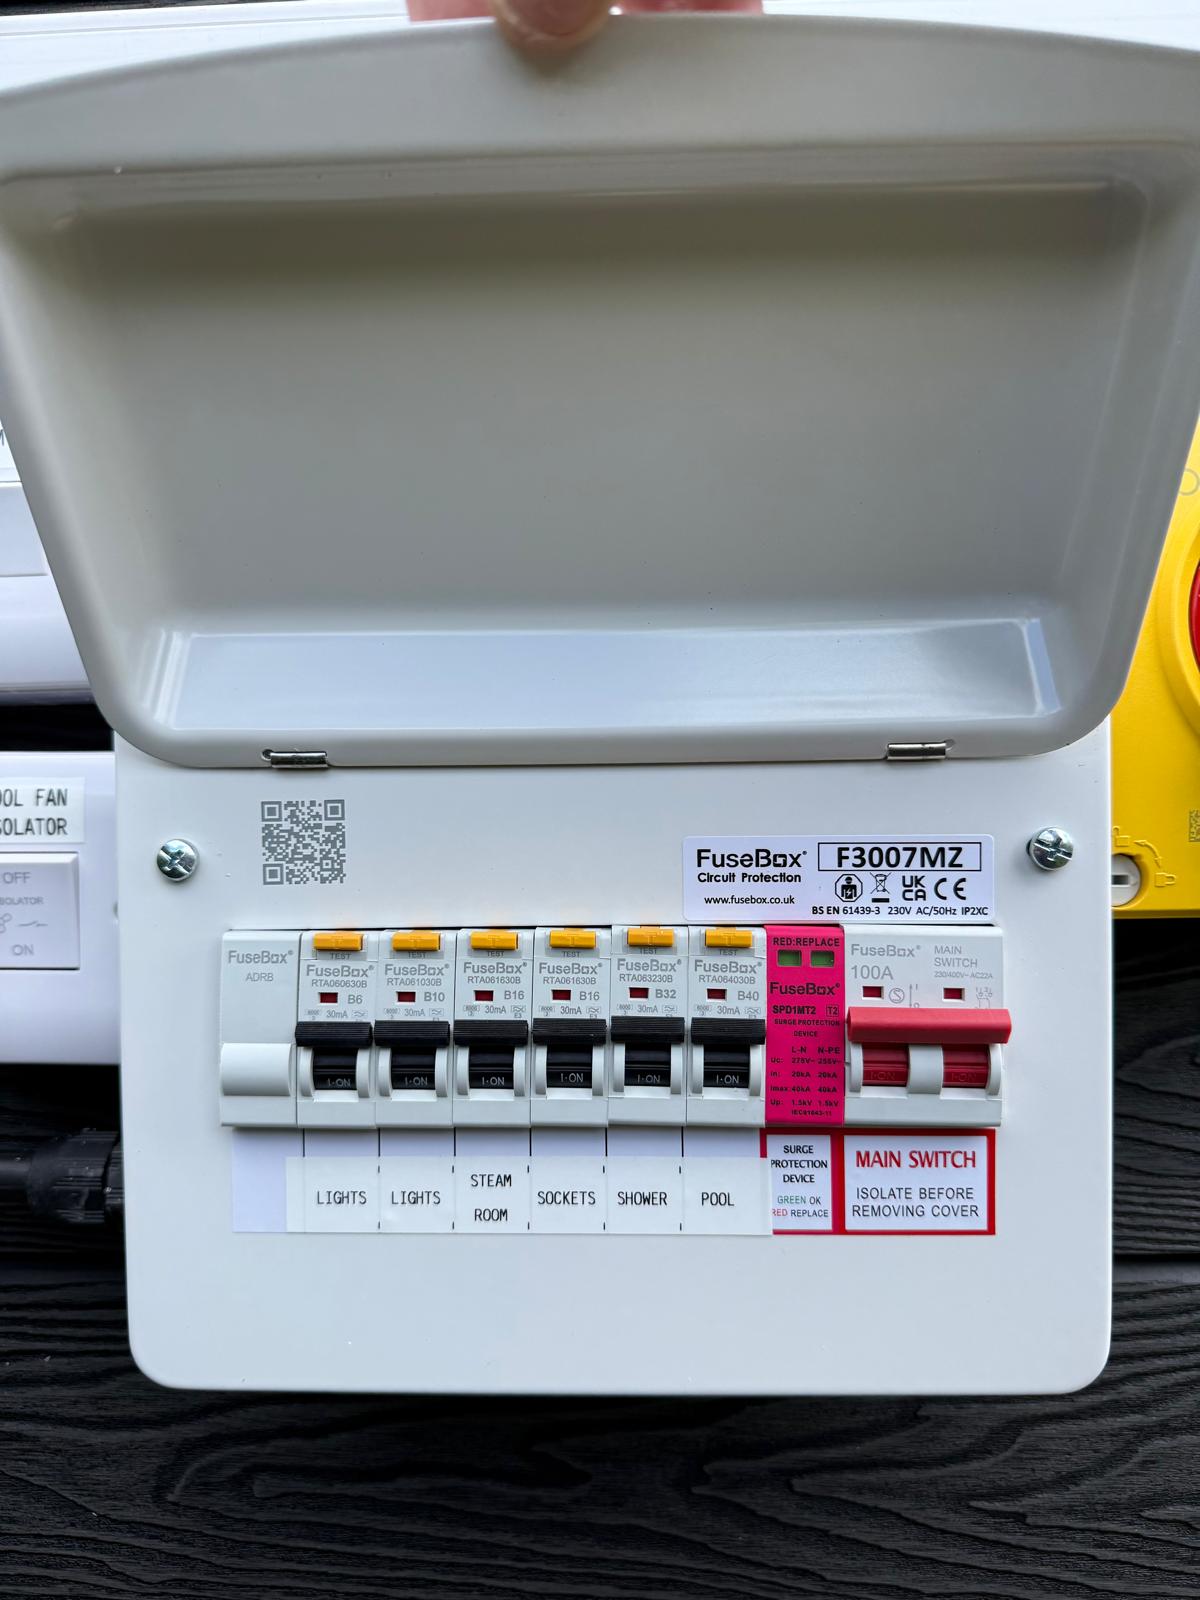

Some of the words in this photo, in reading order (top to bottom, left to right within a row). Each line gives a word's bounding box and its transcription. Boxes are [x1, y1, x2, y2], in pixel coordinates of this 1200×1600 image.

[0, 788, 24, 807] OL
[36, 788, 68, 807] FAN
[0, 817, 68, 836] OLATOR
[837, 847, 963, 869] F3007MZ
[3, 871, 31, 884] OFF
[697, 872, 736, 883] Circuit
[741, 872, 802, 883] Protection
[704, 894, 796, 905] www.fusebox.co.uk
[812, 905, 824, 915] BS
[826, 905, 840, 915] EN
[842, 905, 881, 915] 61439-3
[888, 905, 912, 915] 230V
[916, 905, 957, 917] AC/50Hz
[961, 906, 989, 916] IP2XC
[773, 937, 840, 947] RED:REPLACE
[12, 944, 34, 956] ON
[934, 946, 962, 955] MAIN
[934, 957, 978, 968] SWITCH
[245, 972, 274, 982] ADRB
[850, 965, 894, 981] 100A
[347, 994, 363, 1005] B6
[423, 992, 445, 1002] B10
[504, 990, 525, 1000] B16
[579, 991, 600, 1001] B16
[655, 989, 677, 999] B32
[737, 991, 759, 1001] B40
[326, 1010, 348, 1018] 30mA
[404, 1008, 426, 1017] 30mA
[484, 1005, 507, 1014] 30mA
[560, 1006, 582, 1015] 30mA
[637, 1004, 659, 1013] 30mA
[716, 1005, 741, 1015] 30mA
[772, 1005, 816, 1014] SPD1MT2
[783, 1145, 814, 1154] SURGE
[771, 1159, 828, 1168] PROTECTION
[856, 1150, 900, 1169] MAIN
[908, 1150, 976, 1169] SWITCH
[470, 1173, 512, 1187] STEAM
[783, 1174, 815, 1183] DEVICE
[317, 1190, 367, 1205] LIGHTS
[391, 1190, 441, 1205] LIGHTS
[537, 1190, 596, 1205] SOCKETS
[617, 1191, 668, 1206] SHOWER
[701, 1192, 735, 1206] POOL
[856, 1187, 912, 1200] ISOLATE
[919, 1187, 974, 1200] BEFORE
[777, 1195, 806, 1205] GREEN
[809, 1196, 821, 1205] OK
[474, 1208, 508, 1221] ROOM
[790, 1209, 829, 1218] REPLACE
[852, 1204, 925, 1217] REMOVING
[931, 1204, 979, 1217] COVER
